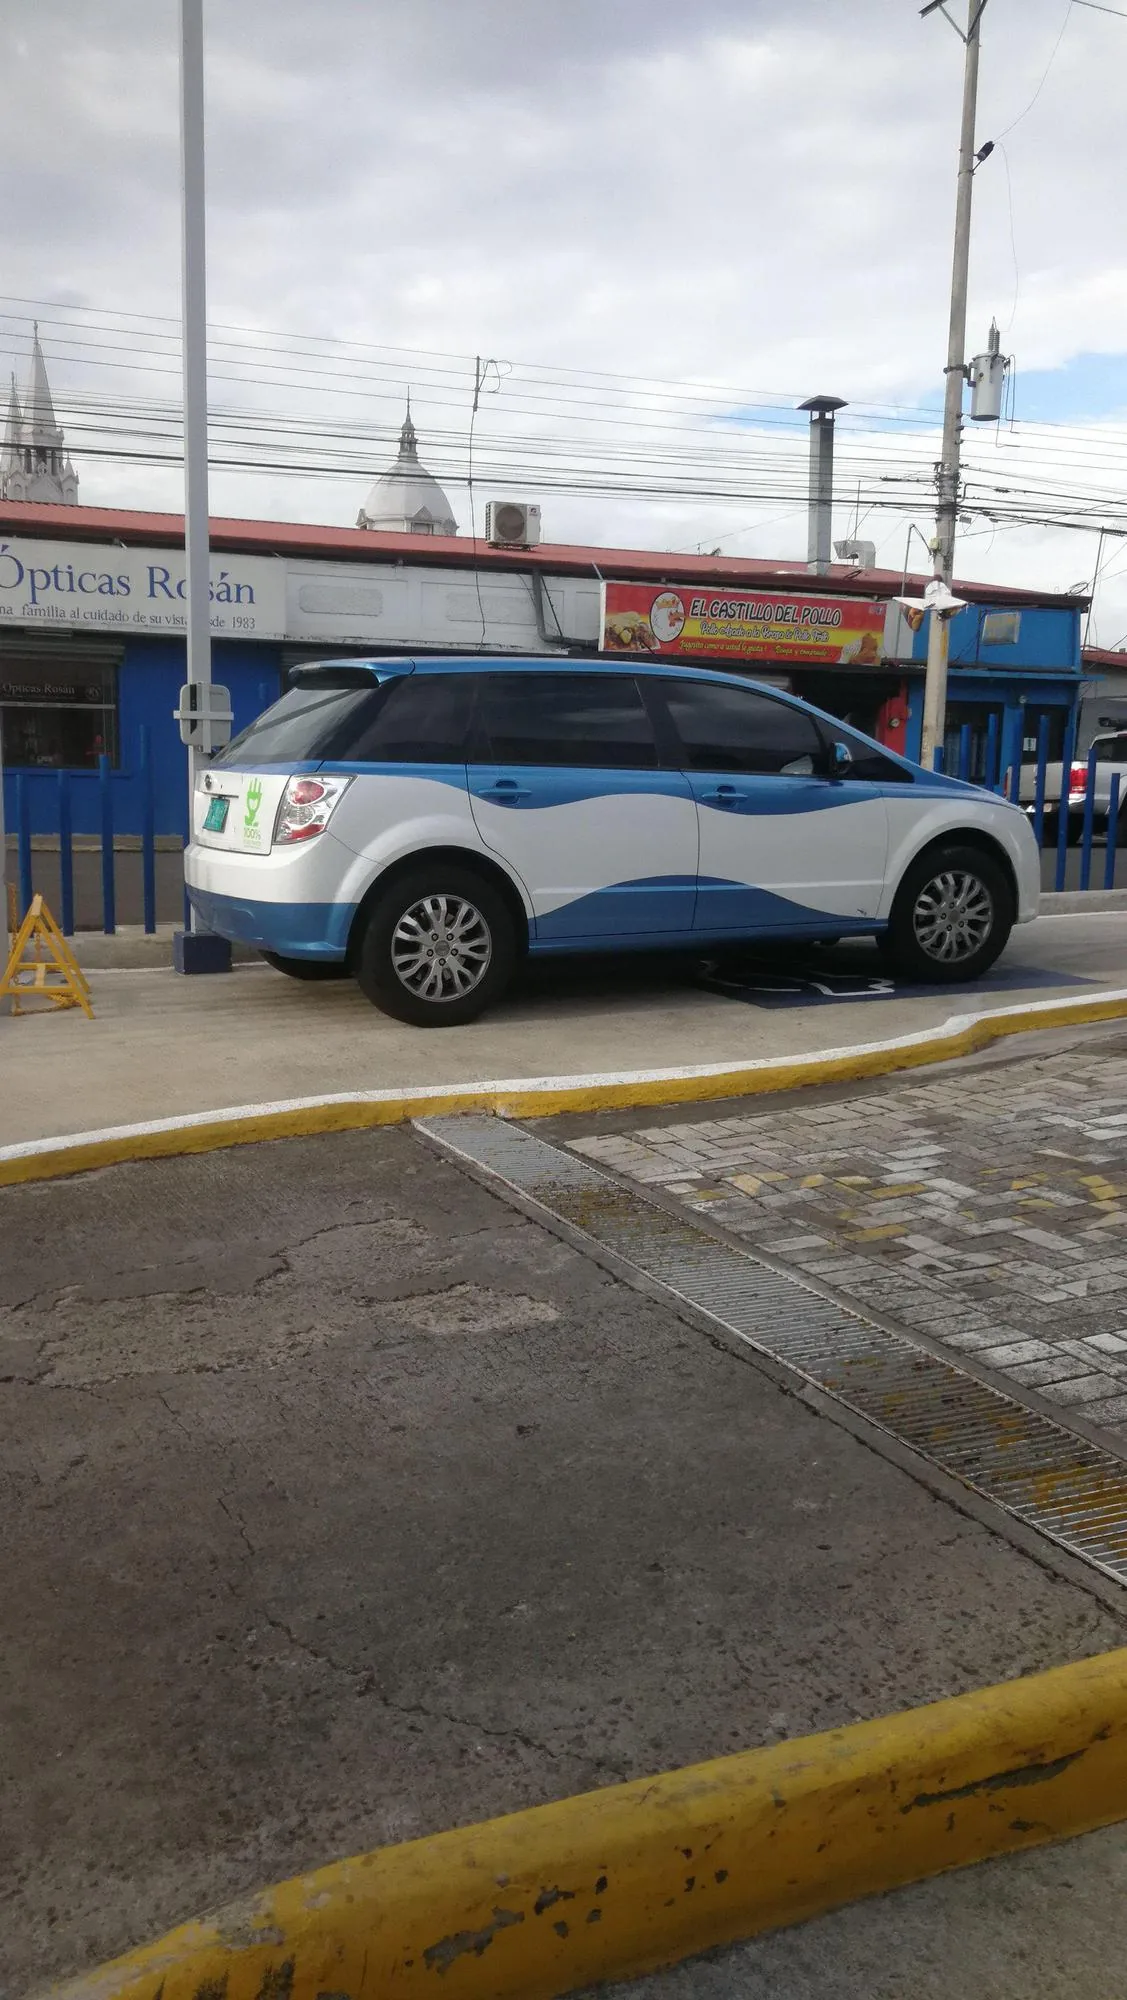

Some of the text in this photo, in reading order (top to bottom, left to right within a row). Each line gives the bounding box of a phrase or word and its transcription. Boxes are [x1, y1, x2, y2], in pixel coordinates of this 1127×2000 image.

[0, 544, 256, 605] Ópticas Rán
[22, 603, 66, 618] familia
[70, 606, 80, 619] al
[83, 609, 129, 622] cuidado
[133, 611, 146, 624] de
[150, 615, 162, 624] su
[164, 613, 187, 626] vist
[232, 616, 255, 630] 1983
[690, 598, 841, 626] EL CASTILLO DEL POLLO
